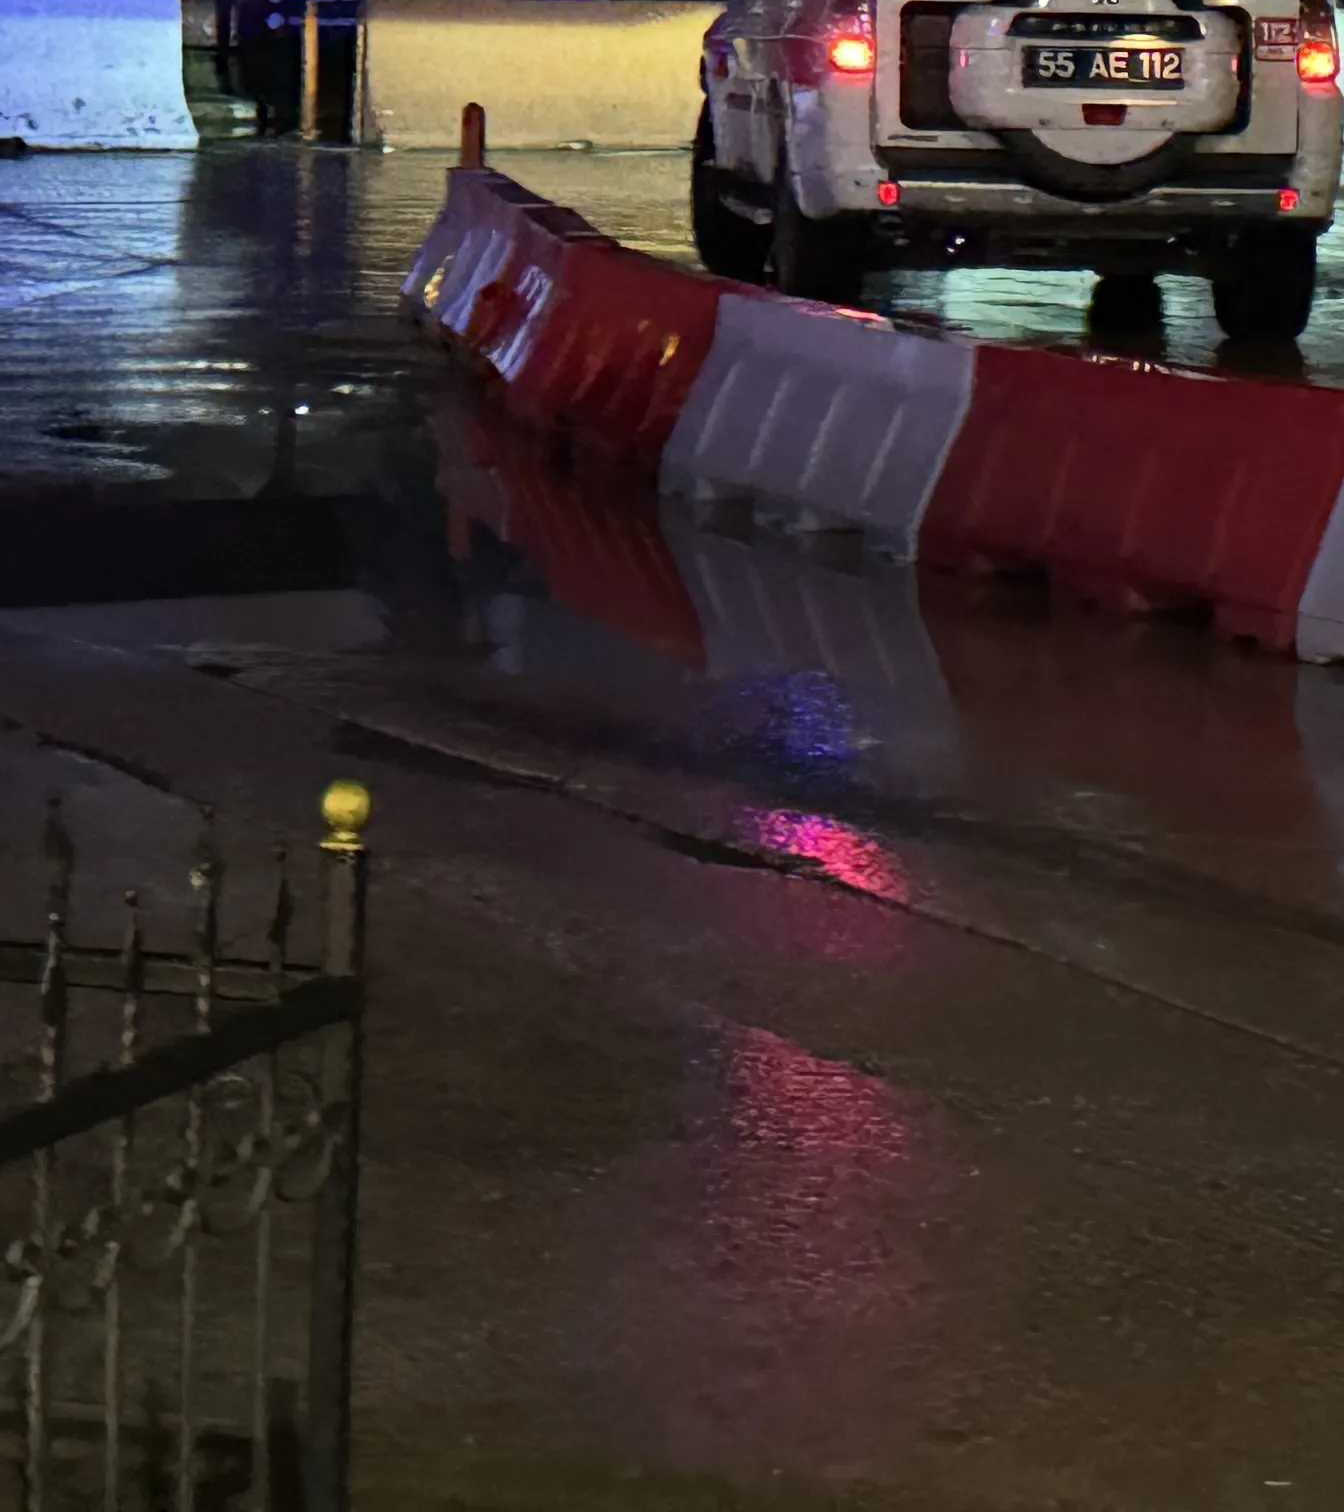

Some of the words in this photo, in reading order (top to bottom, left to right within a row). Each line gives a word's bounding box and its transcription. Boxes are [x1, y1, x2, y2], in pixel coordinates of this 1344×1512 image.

[1037, 51, 1075, 79] 55
[1088, 50, 1129, 80] AE
[1139, 51, 1182, 80] 112
